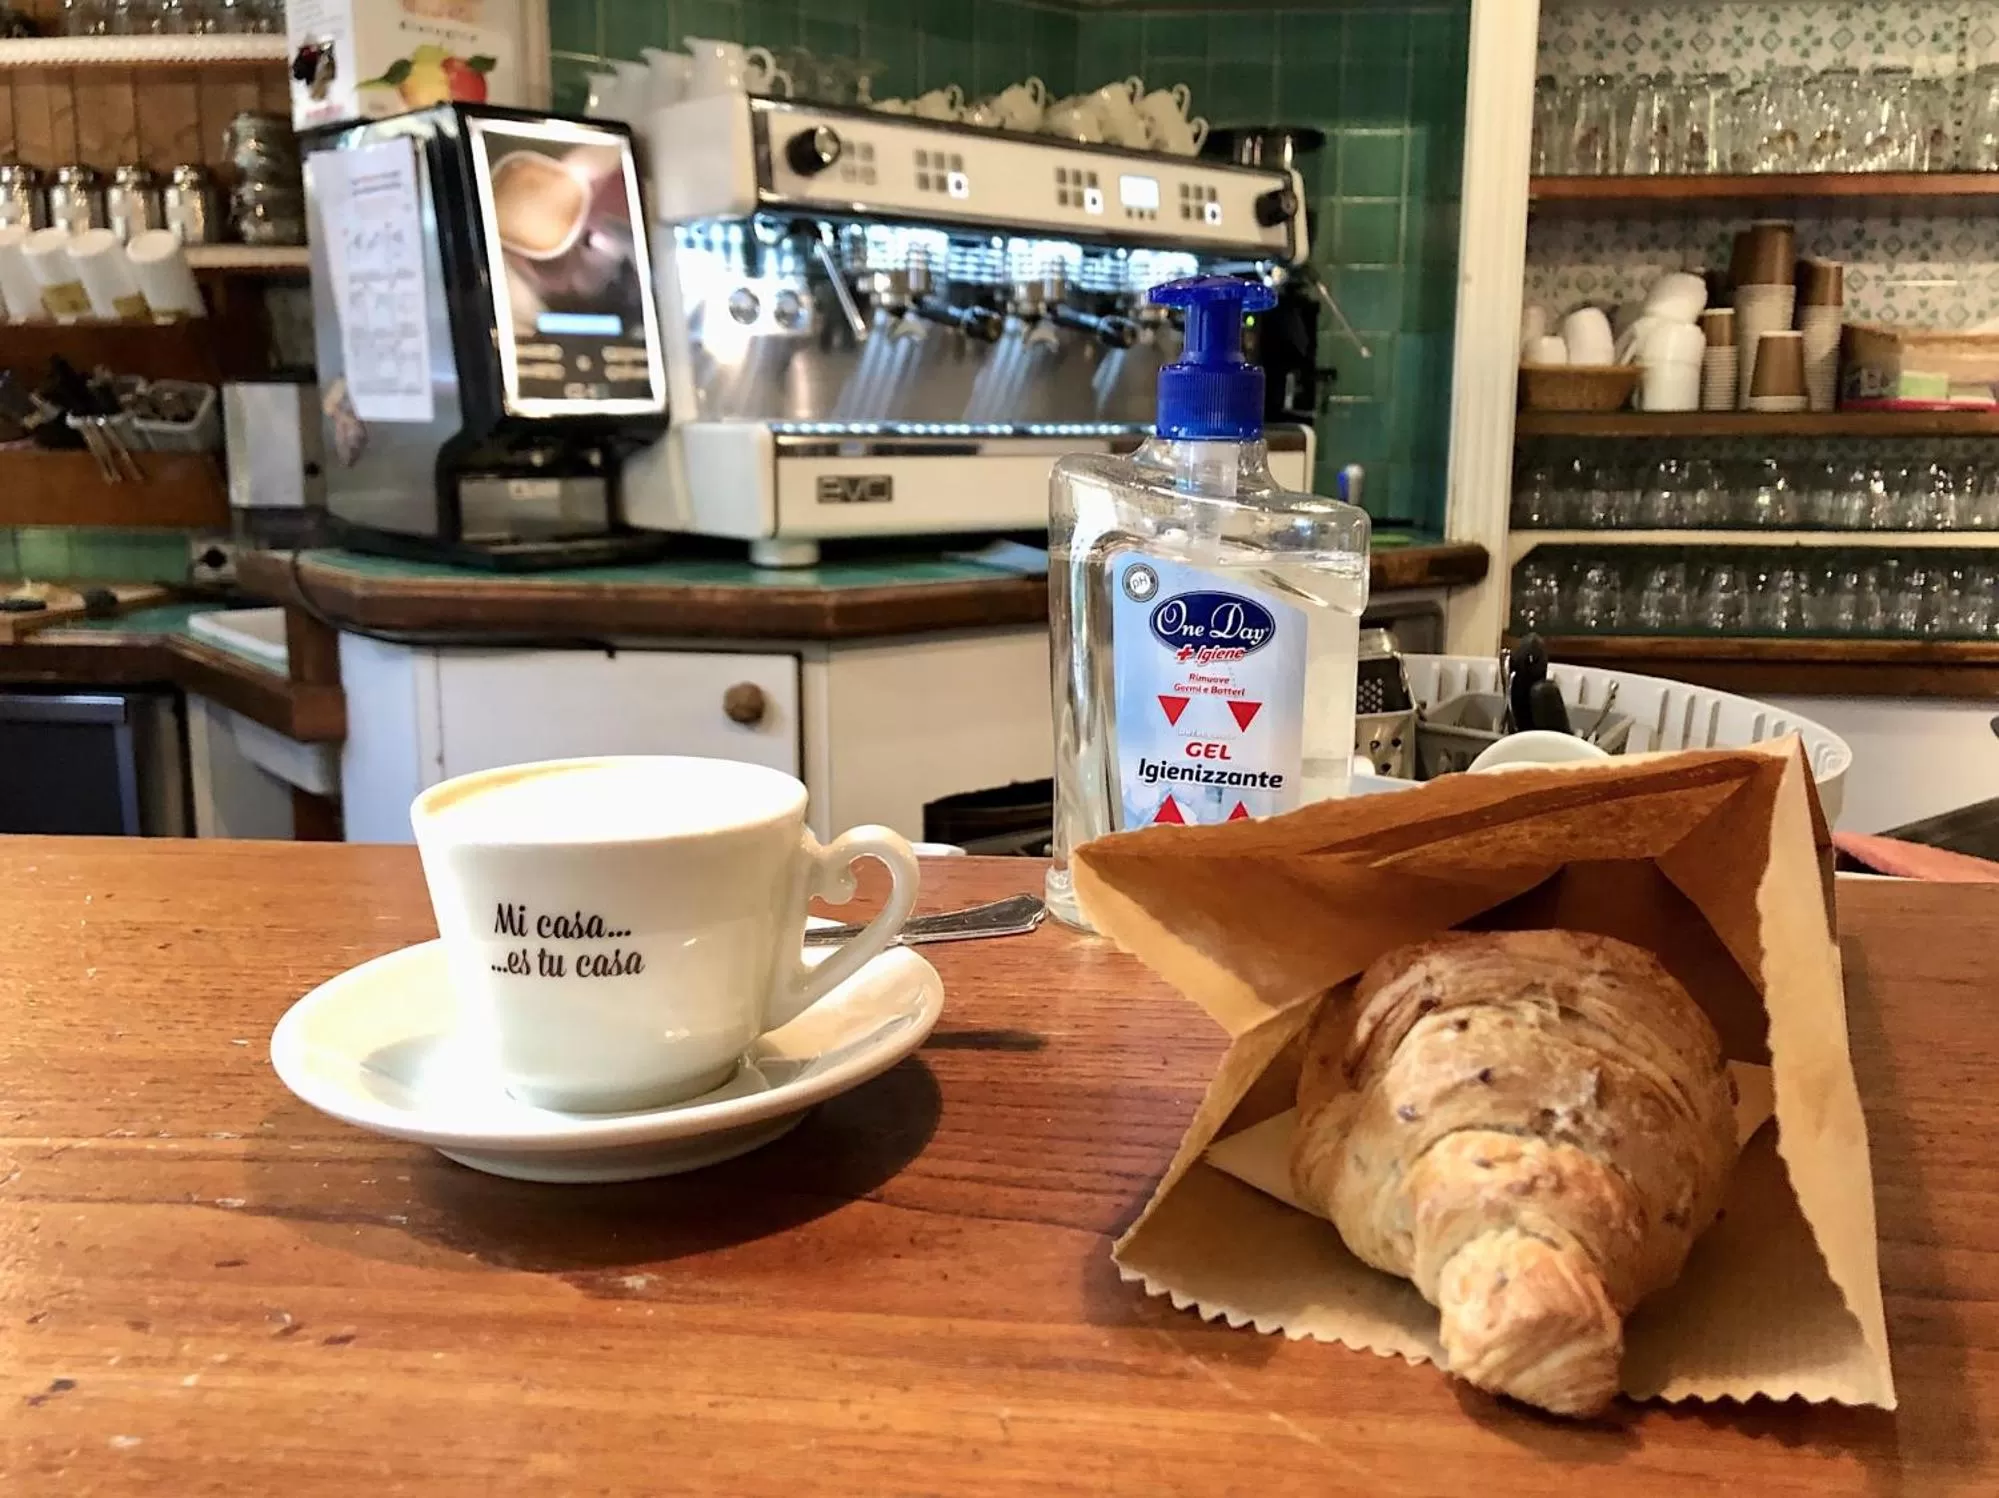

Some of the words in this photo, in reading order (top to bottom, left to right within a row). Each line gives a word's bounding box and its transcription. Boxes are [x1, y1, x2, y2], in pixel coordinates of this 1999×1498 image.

[1132, 575, 1148, 590] pH
[1156, 600, 1204, 635] One
[1209, 602, 1265, 645] Day
[1173, 682, 1202, 694] Germi
[1202, 686, 1209, 694] e
[1188, 672, 1230, 685] Rimuove
[1185, 741, 1232, 760] GEL
[1138, 758, 1284, 789] Igienizzante
[494, 902, 528, 937] Mi
[536, 910, 632, 939] casa...
[491, 948, 531, 976] ...es
[537, 947, 567, 977] tu
[576, 948, 646, 978] casa
